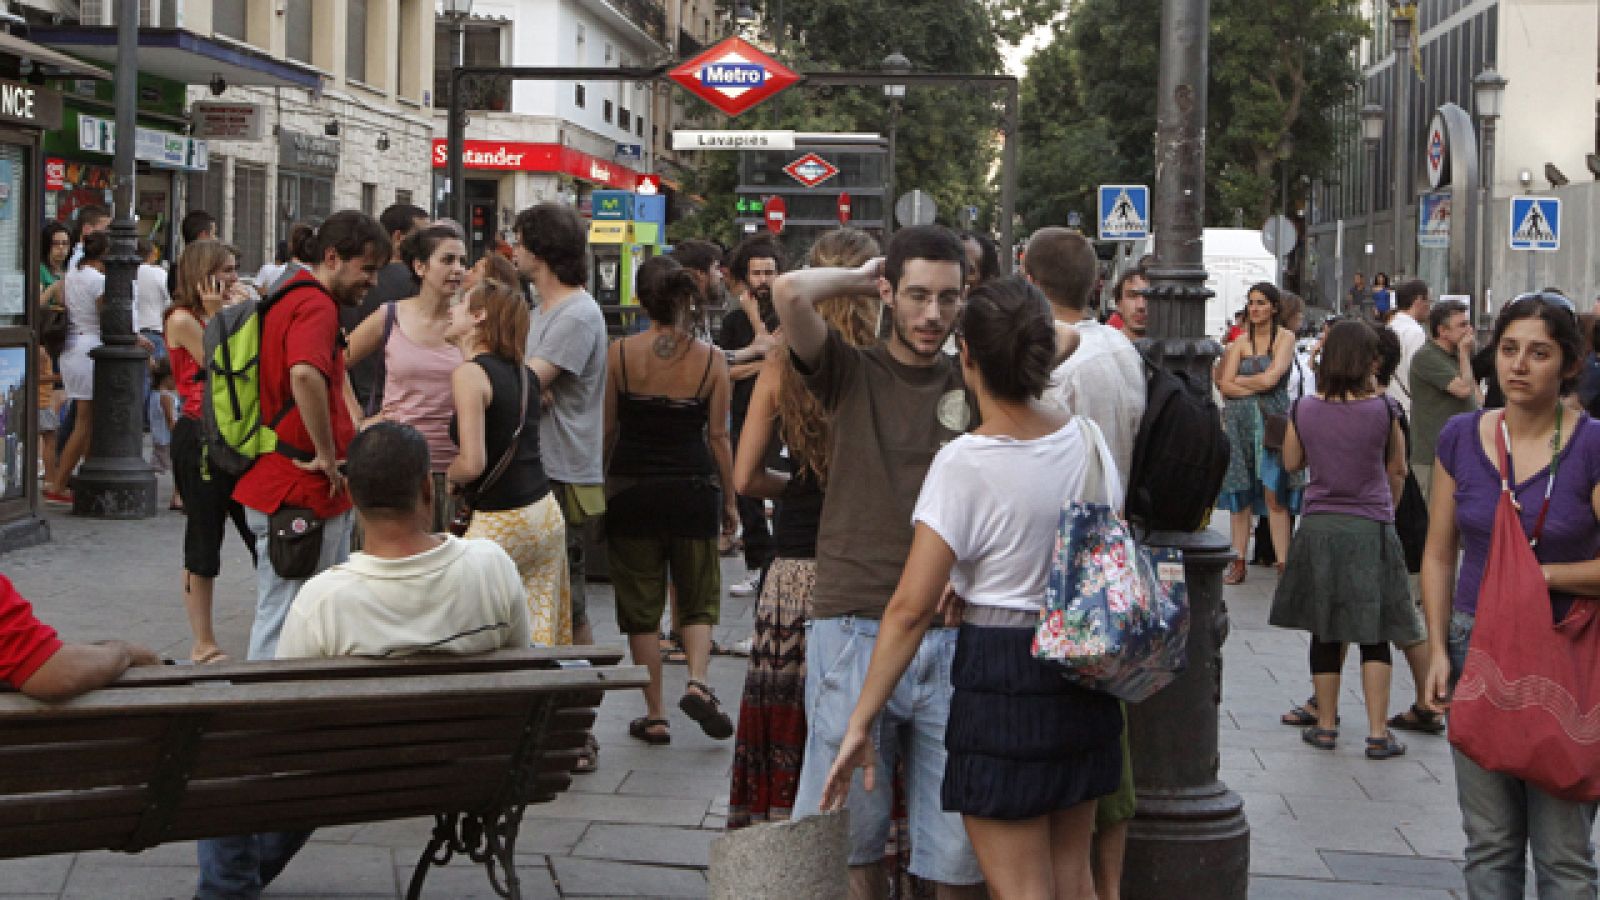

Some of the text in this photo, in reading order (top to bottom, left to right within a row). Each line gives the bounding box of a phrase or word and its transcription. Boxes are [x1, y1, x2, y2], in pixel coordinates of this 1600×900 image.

[707, 67, 760, 83] Metro
[2, 84, 36, 118] NCE
[435, 144, 523, 165] Stander
